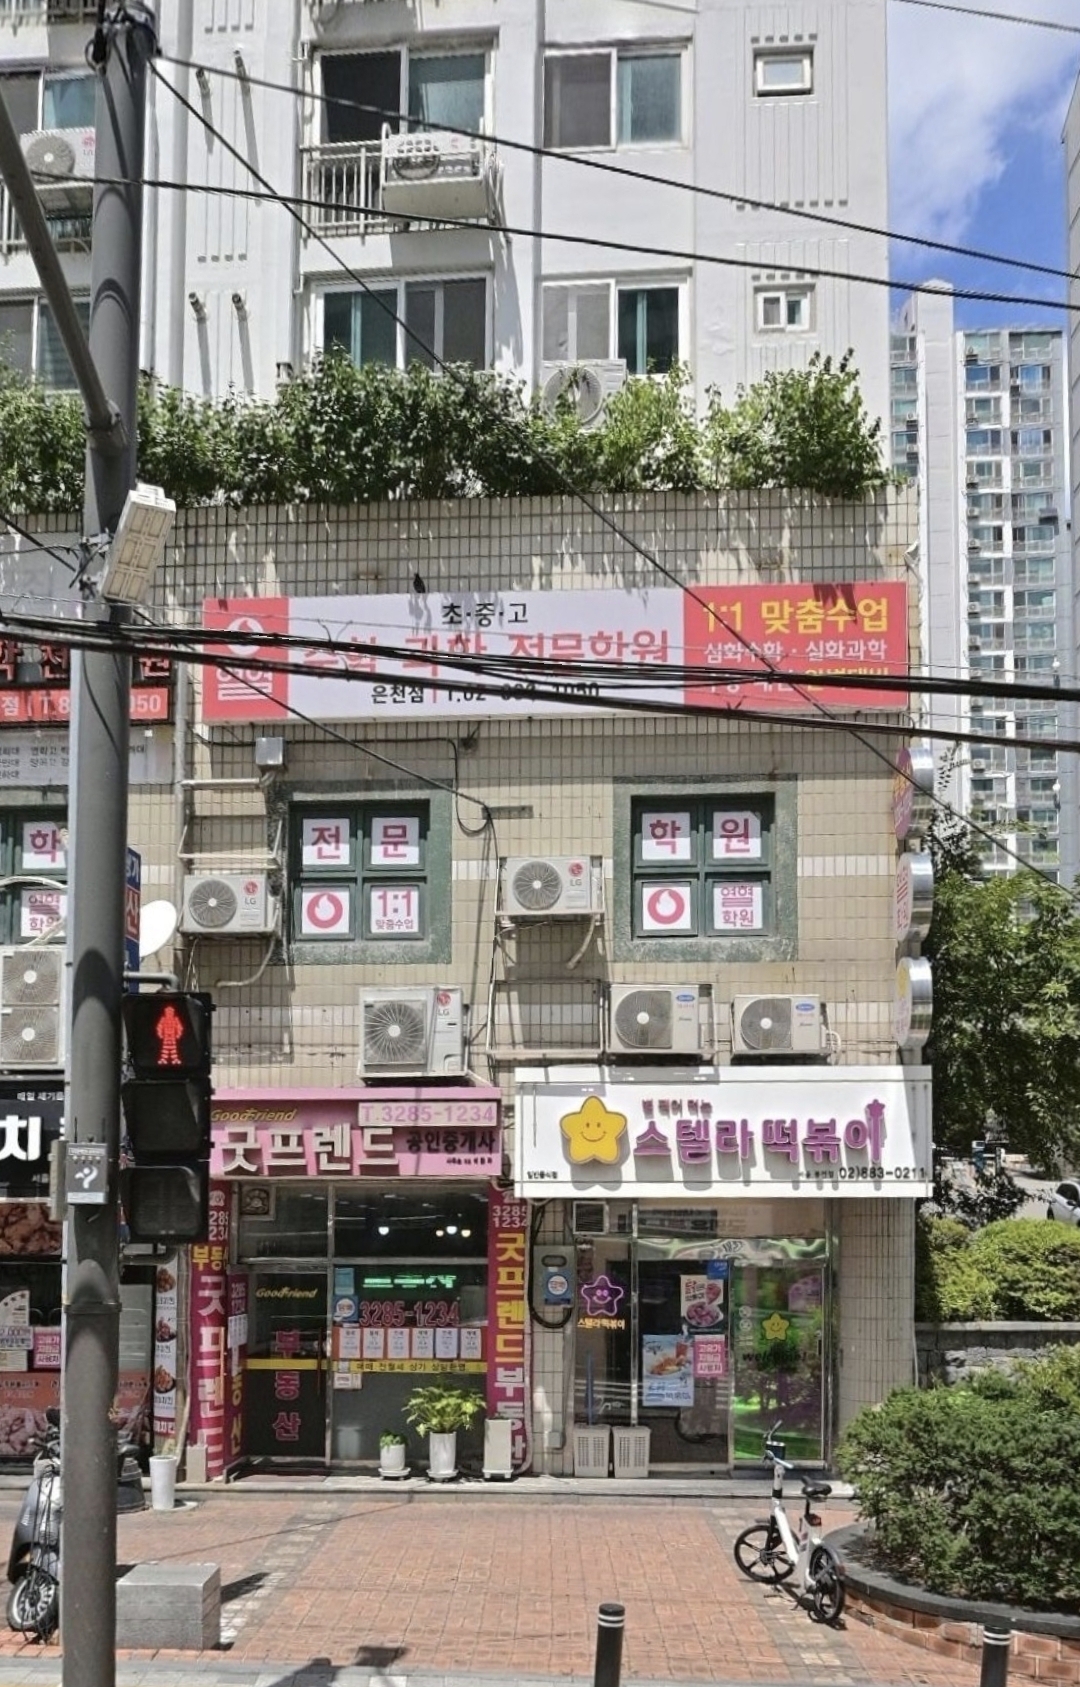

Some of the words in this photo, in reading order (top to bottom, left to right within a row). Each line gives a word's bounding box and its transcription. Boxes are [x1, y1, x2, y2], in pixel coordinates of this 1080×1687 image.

[760, 597, 888, 634] 맞춤수업
[371, 683, 424, 703] 은천점
[29, 829, 60, 863] 학
[311, 825, 341, 859] 전
[380, 824, 409, 858] 문
[649, 819, 682, 854] 학
[719, 818, 750, 853] 원
[377, 890, 412, 917] 1:1
[375, 918, 414, 930] 맞춤수업
[722, 909, 753, 927] 학원
[361, 1105, 495, 1122] T.3285-1234
[220, 1123, 399, 1171] 굿프렌드
[406, 1130, 496, 1155] 공인중개사
[838, 1165, 925, 1180] 02)883-0211
[360, 1301, 460, 1327] 3285-1234
[273, 1330, 301, 1441] 부동산
